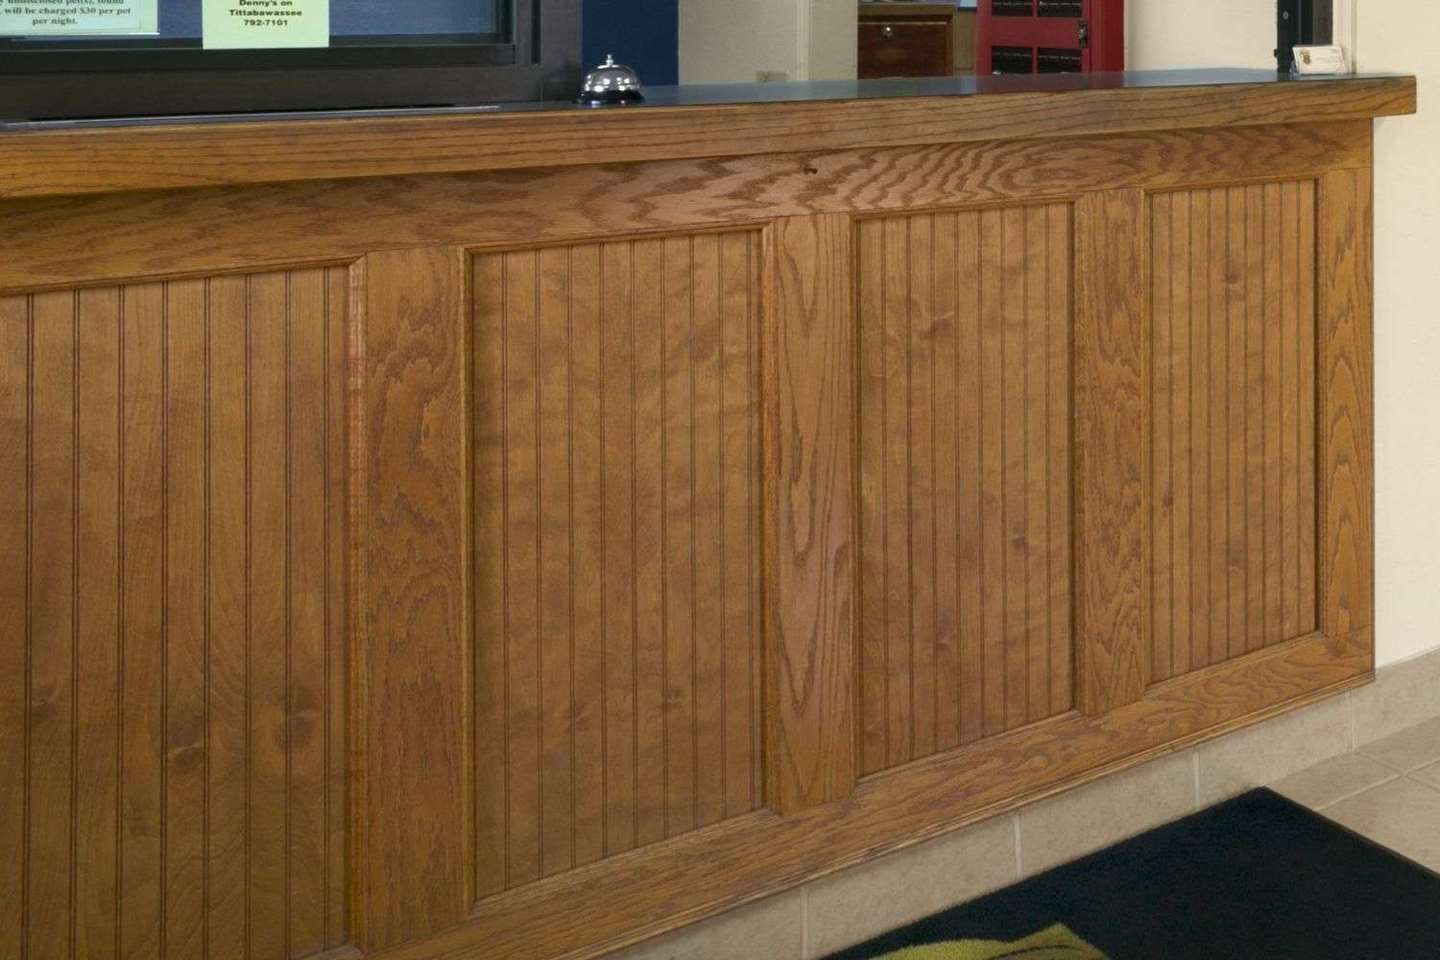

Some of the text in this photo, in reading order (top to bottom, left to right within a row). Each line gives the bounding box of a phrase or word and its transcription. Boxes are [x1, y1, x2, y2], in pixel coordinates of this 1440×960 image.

[239, 0, 278, 7] Denny's
[39, 7, 77, 16] charged
[99, 8, 113, 16] per
[32, 18, 47, 26] per
